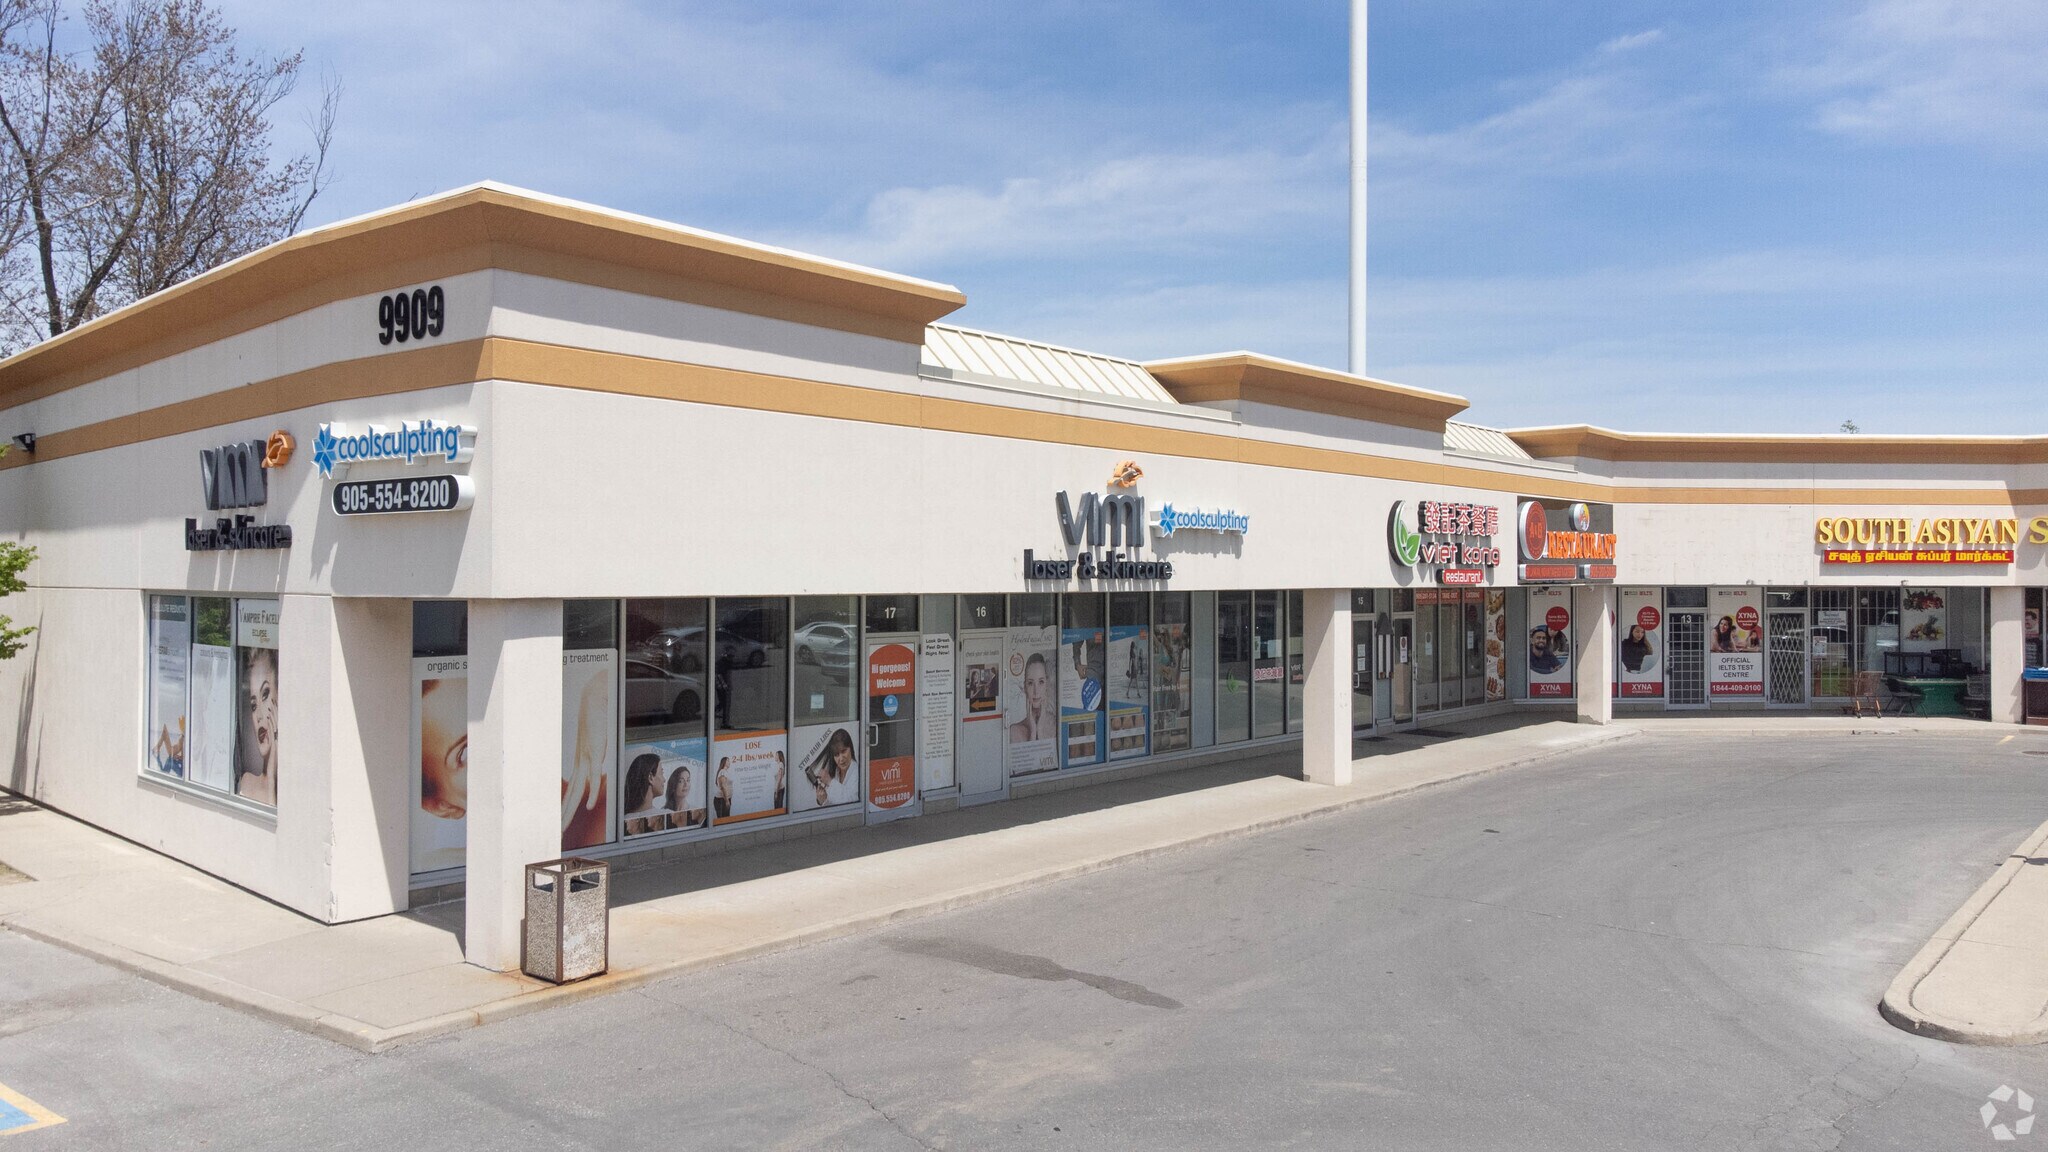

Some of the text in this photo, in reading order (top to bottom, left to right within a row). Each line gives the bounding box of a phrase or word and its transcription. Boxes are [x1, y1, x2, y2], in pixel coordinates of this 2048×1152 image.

[378, 285, 445, 345] 9909
[338, 419, 459, 463] coolsculpting
[342, 479, 450, 512] 905-554-8200
[1055, 490, 1145, 547] vimi
[1177, 507, 1249, 534] coolsculpting
[1425, 501, 1499, 536] 發記茶餐廳
[216, 518, 232, 550] &
[1818, 517, 1912, 544] SOUTH
[1914, 517, 2019, 544] ASIYAN
[1546, 531, 1616, 559] RESTAURANT
[1024, 549, 1173, 580] laser & skincare
[240, 608, 260, 624] VAMPIRE
[884, 607, 896, 619] 17
[976, 606, 986, 618] 16
[1681, 615, 1692, 624] 13
[570, 653, 609, 663] treatment
[427, 660, 460, 673] organic
[872, 662, 911, 674] Hi gorgeous!
[876, 678, 906, 689] Welcome
[745, 741, 762, 750] LOSE
[798, 754, 811, 770] STOP
[881, 766, 900, 780] vimi
